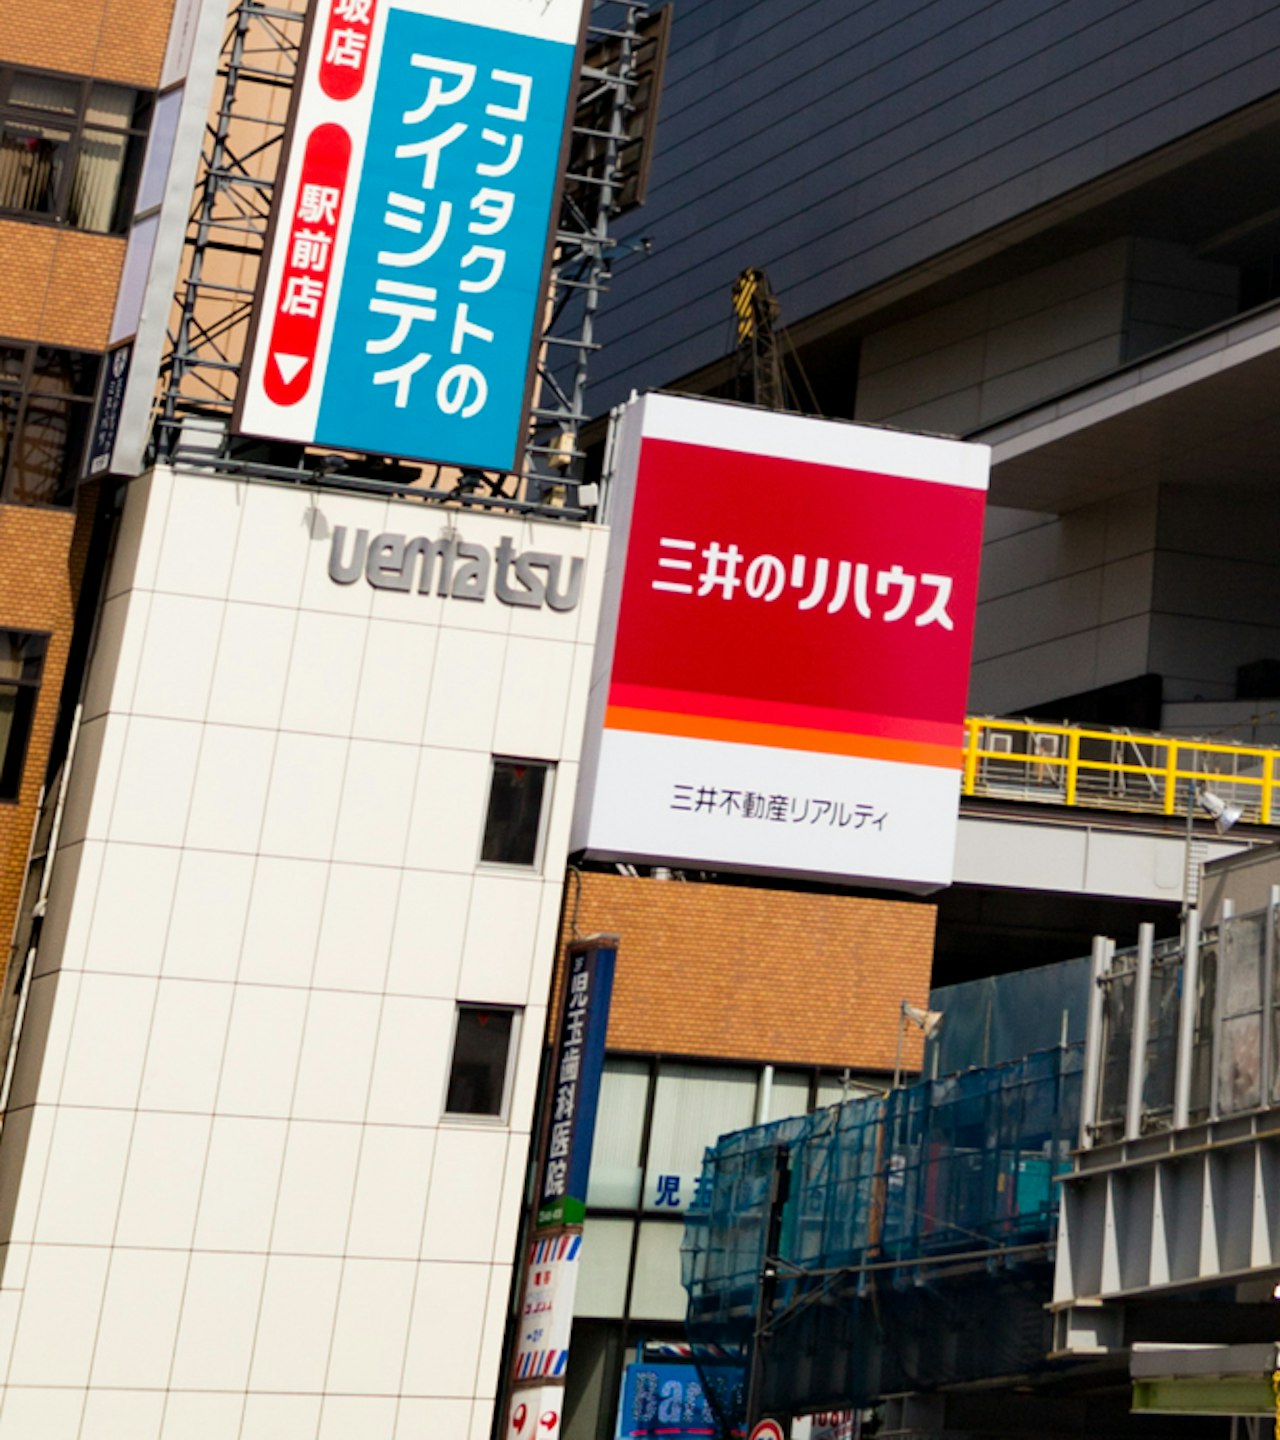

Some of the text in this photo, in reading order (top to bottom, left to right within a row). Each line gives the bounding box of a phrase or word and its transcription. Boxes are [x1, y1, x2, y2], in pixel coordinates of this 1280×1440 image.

[281, 183, 341, 320] 駅前店
[365, 52, 477, 408] アイシティ
[435, 68, 534, 420] コンタクトの
[328, 525, 585, 612] uematsu
[652, 537, 954, 631] 三井のリハウス
[670, 784, 888, 831] 三井不動産リアルティ
[544, 970, 590, 1199] 児玉歯科医院
